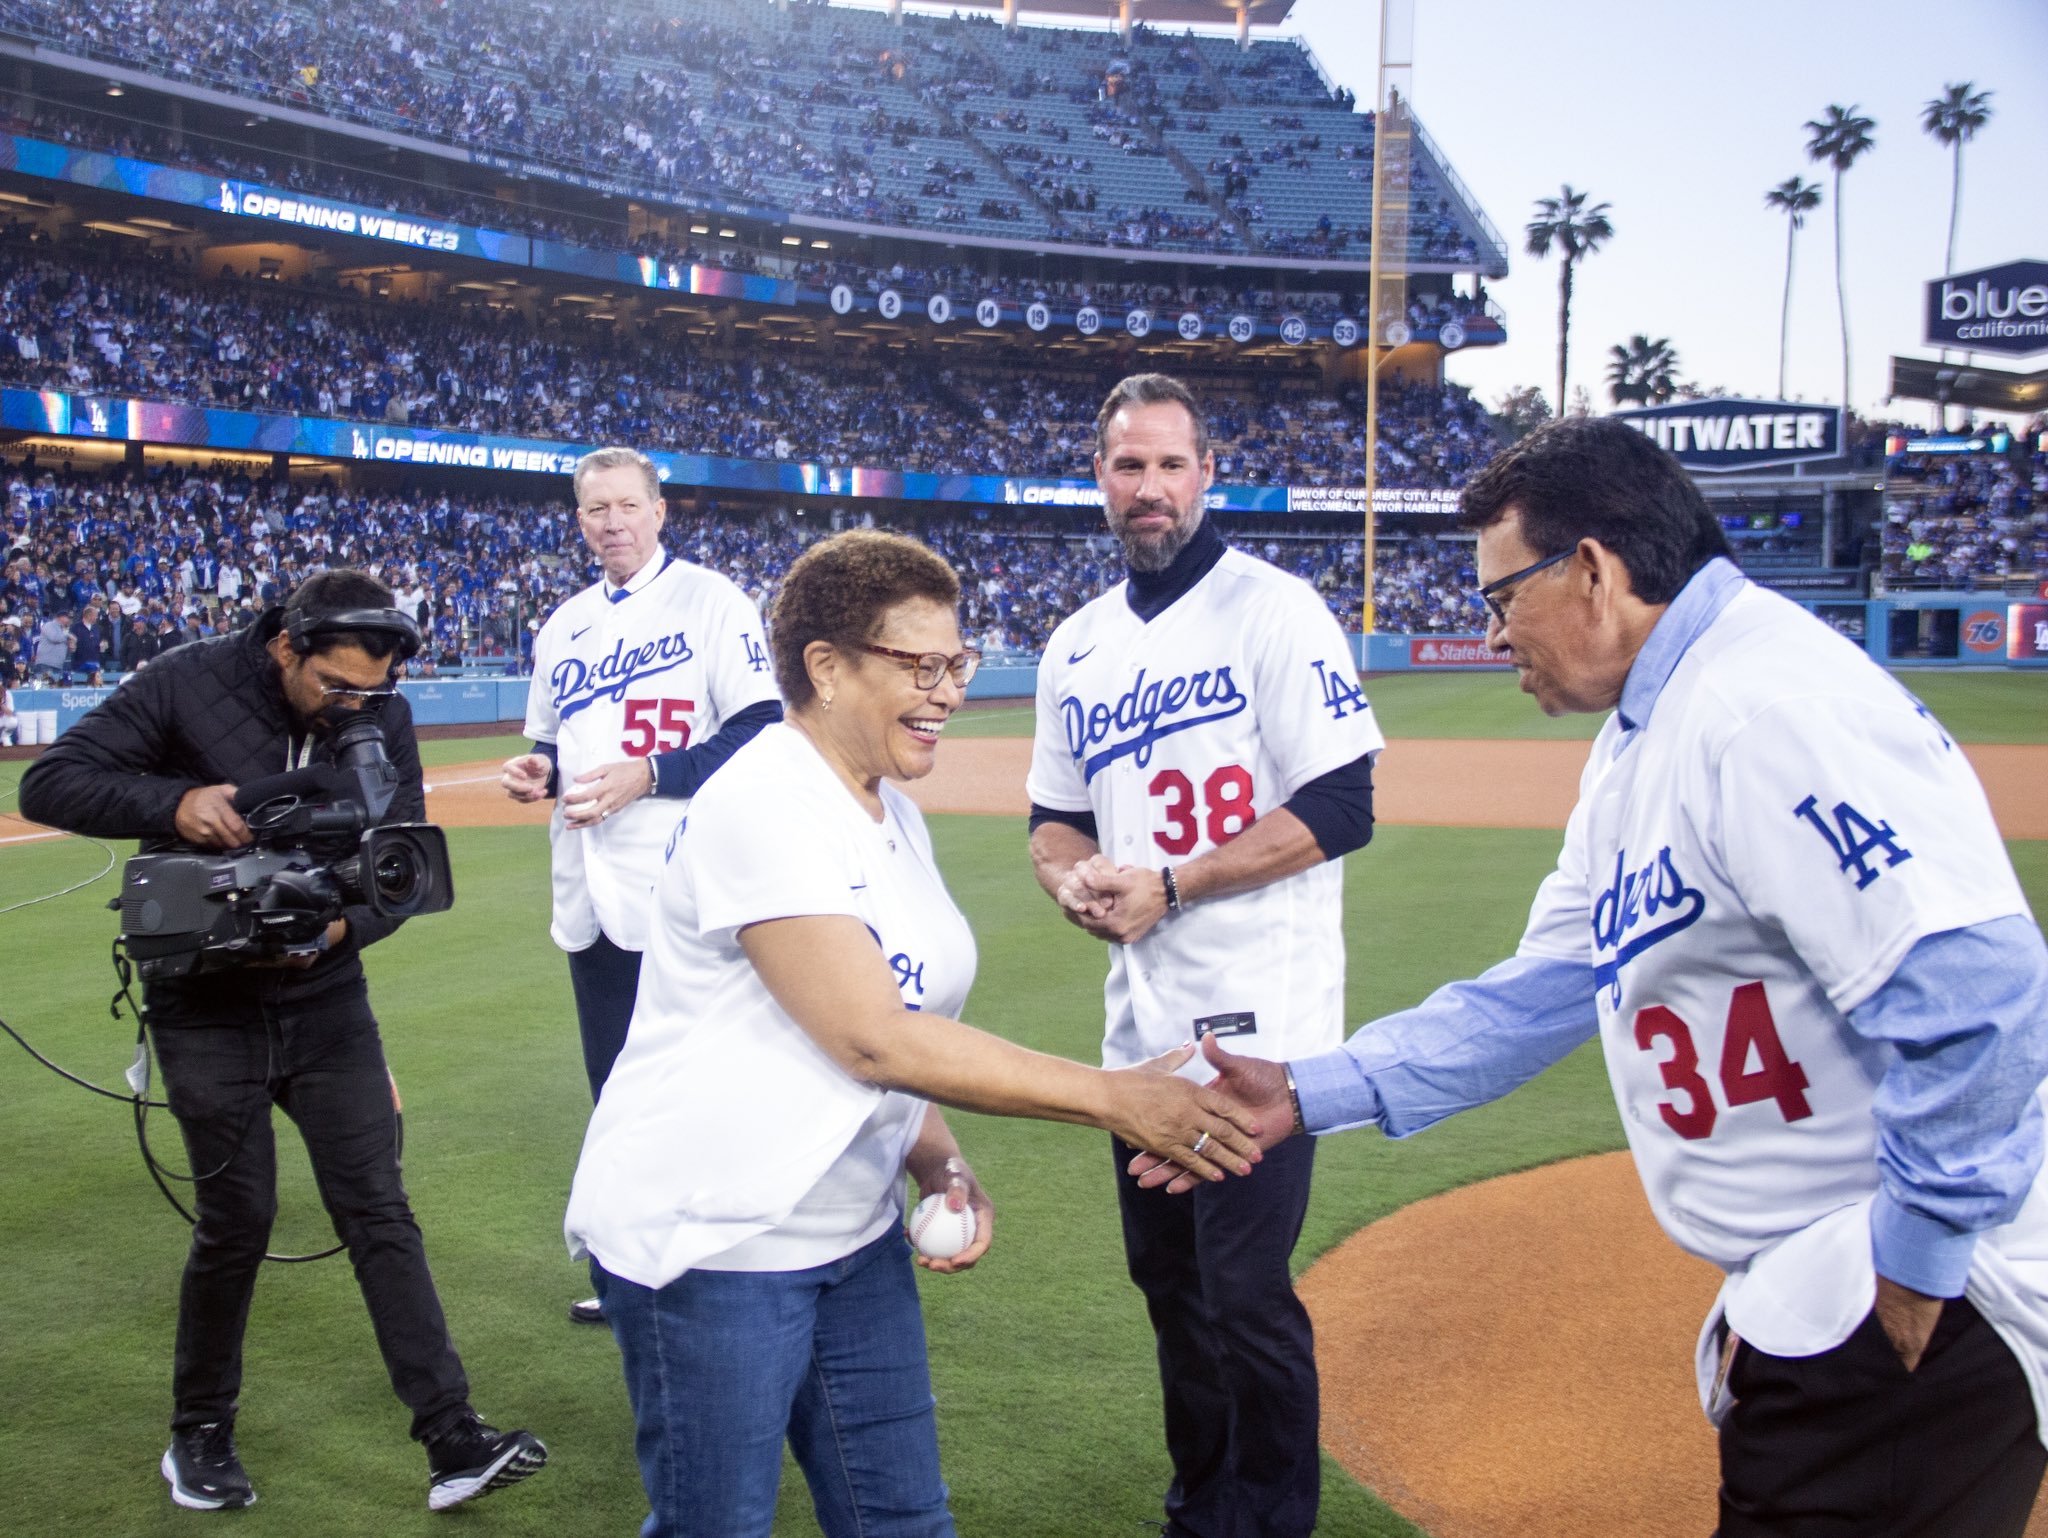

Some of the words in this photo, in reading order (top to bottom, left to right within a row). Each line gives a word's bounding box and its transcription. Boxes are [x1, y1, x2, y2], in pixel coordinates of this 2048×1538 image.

[475, 154, 489, 164] FOR
[495, 158, 509, 169] FAN
[522, 164, 560, 180] ASSISTANCE
[565, 174, 581, 185] CALL
[651, 191, 665, 201] TEXT
[220, 181, 237, 214] LA
[243, 193, 356, 233] OPENING
[1941, 277, 2048, 320] blue
[980, 305, 994, 322] 14
[1031, 309, 1045, 326] 19
[1078, 313, 1097, 330] 20
[1128, 316, 1147, 332] 24
[1180, 319, 1199, 335] 32
[1231, 321, 1250, 337] 39
[1283, 323, 1303, 339] 42
[1335, 325, 1354, 340] 53
[41, 444, 75, 456] DOGS
[352, 429, 369, 460] LA
[375, 438, 488, 467] OPENING
[1023, 486, 1106, 506] OPENIN
[1292, 487, 1327, 500] MAYOR
[1328, 488, 1343, 500] OF
[1344, 488, 1366, 500] OUR
[1404, 501, 1440, 513] KAREN
[1966, 619, 2000, 644] 76
[740, 632, 770, 673] LA
[551, 630, 693, 709] Dodgers
[1310, 659, 1369, 720] LA
[620, 698, 695, 758] 55
[1060, 665, 1247, 769] Dodgers
[1148, 764, 1256, 856] 38
[1793, 794, 1913, 892] LA
[1634, 980, 1813, 1140] 34
